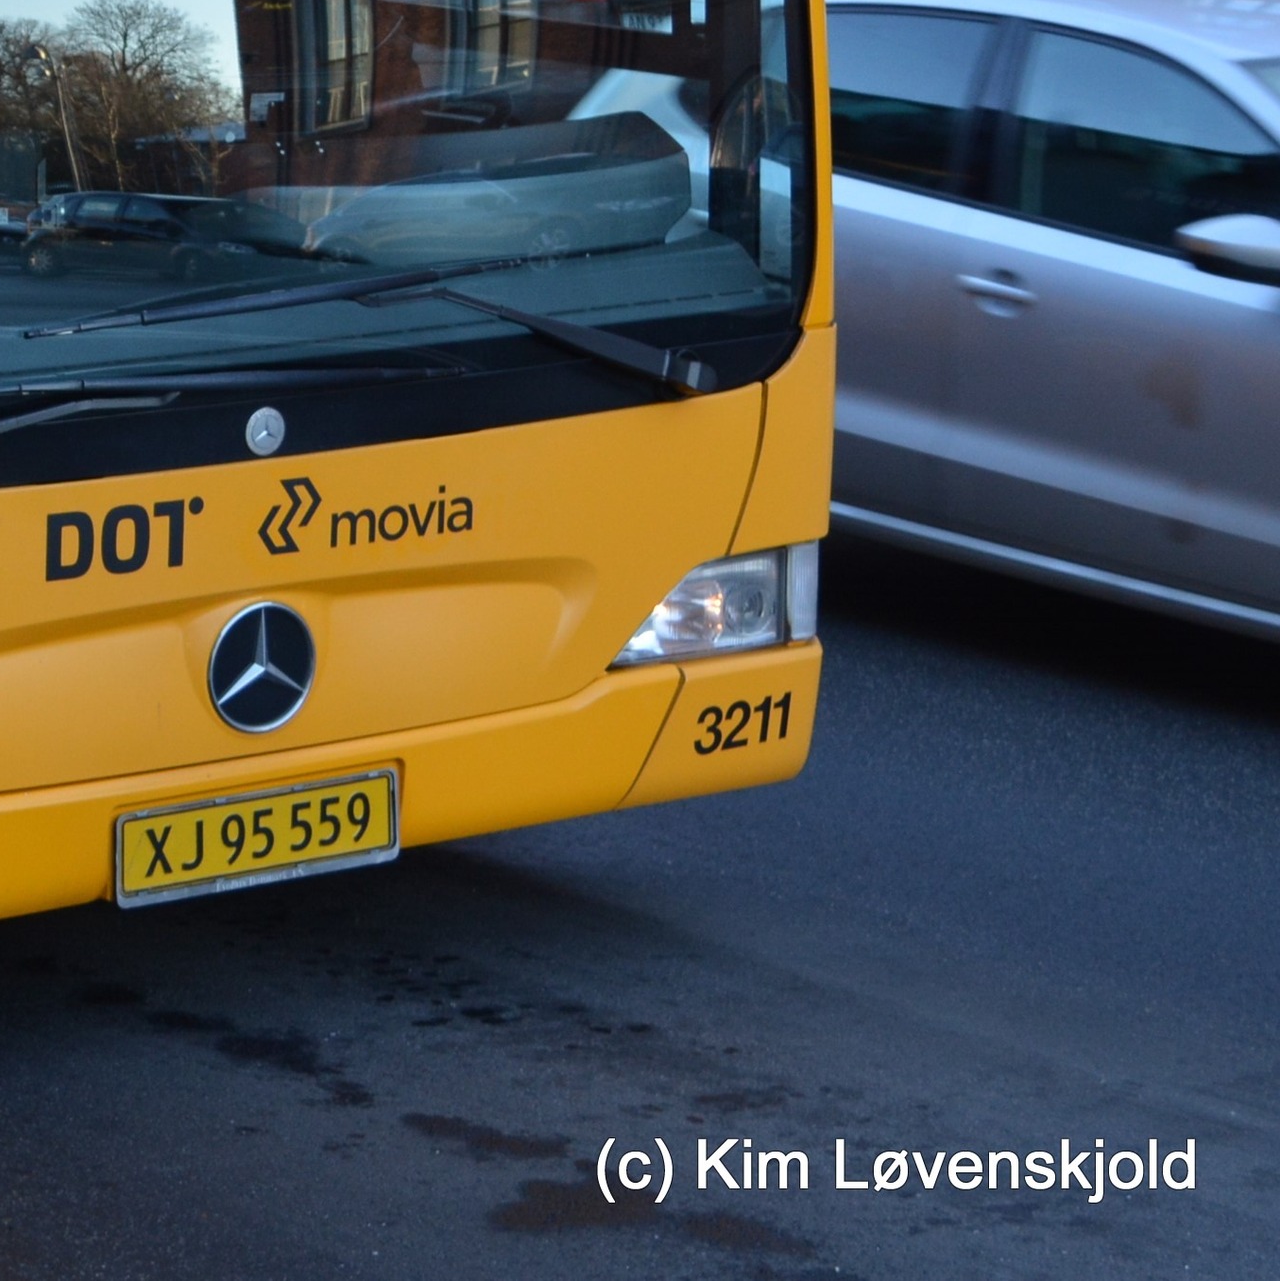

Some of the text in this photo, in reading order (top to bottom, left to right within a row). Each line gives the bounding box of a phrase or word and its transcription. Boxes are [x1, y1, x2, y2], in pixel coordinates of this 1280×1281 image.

[45, 485, 474, 582] DOT movia
[694, 691, 792, 755] 3211
[145, 791, 372, 878] XJ 95 559
